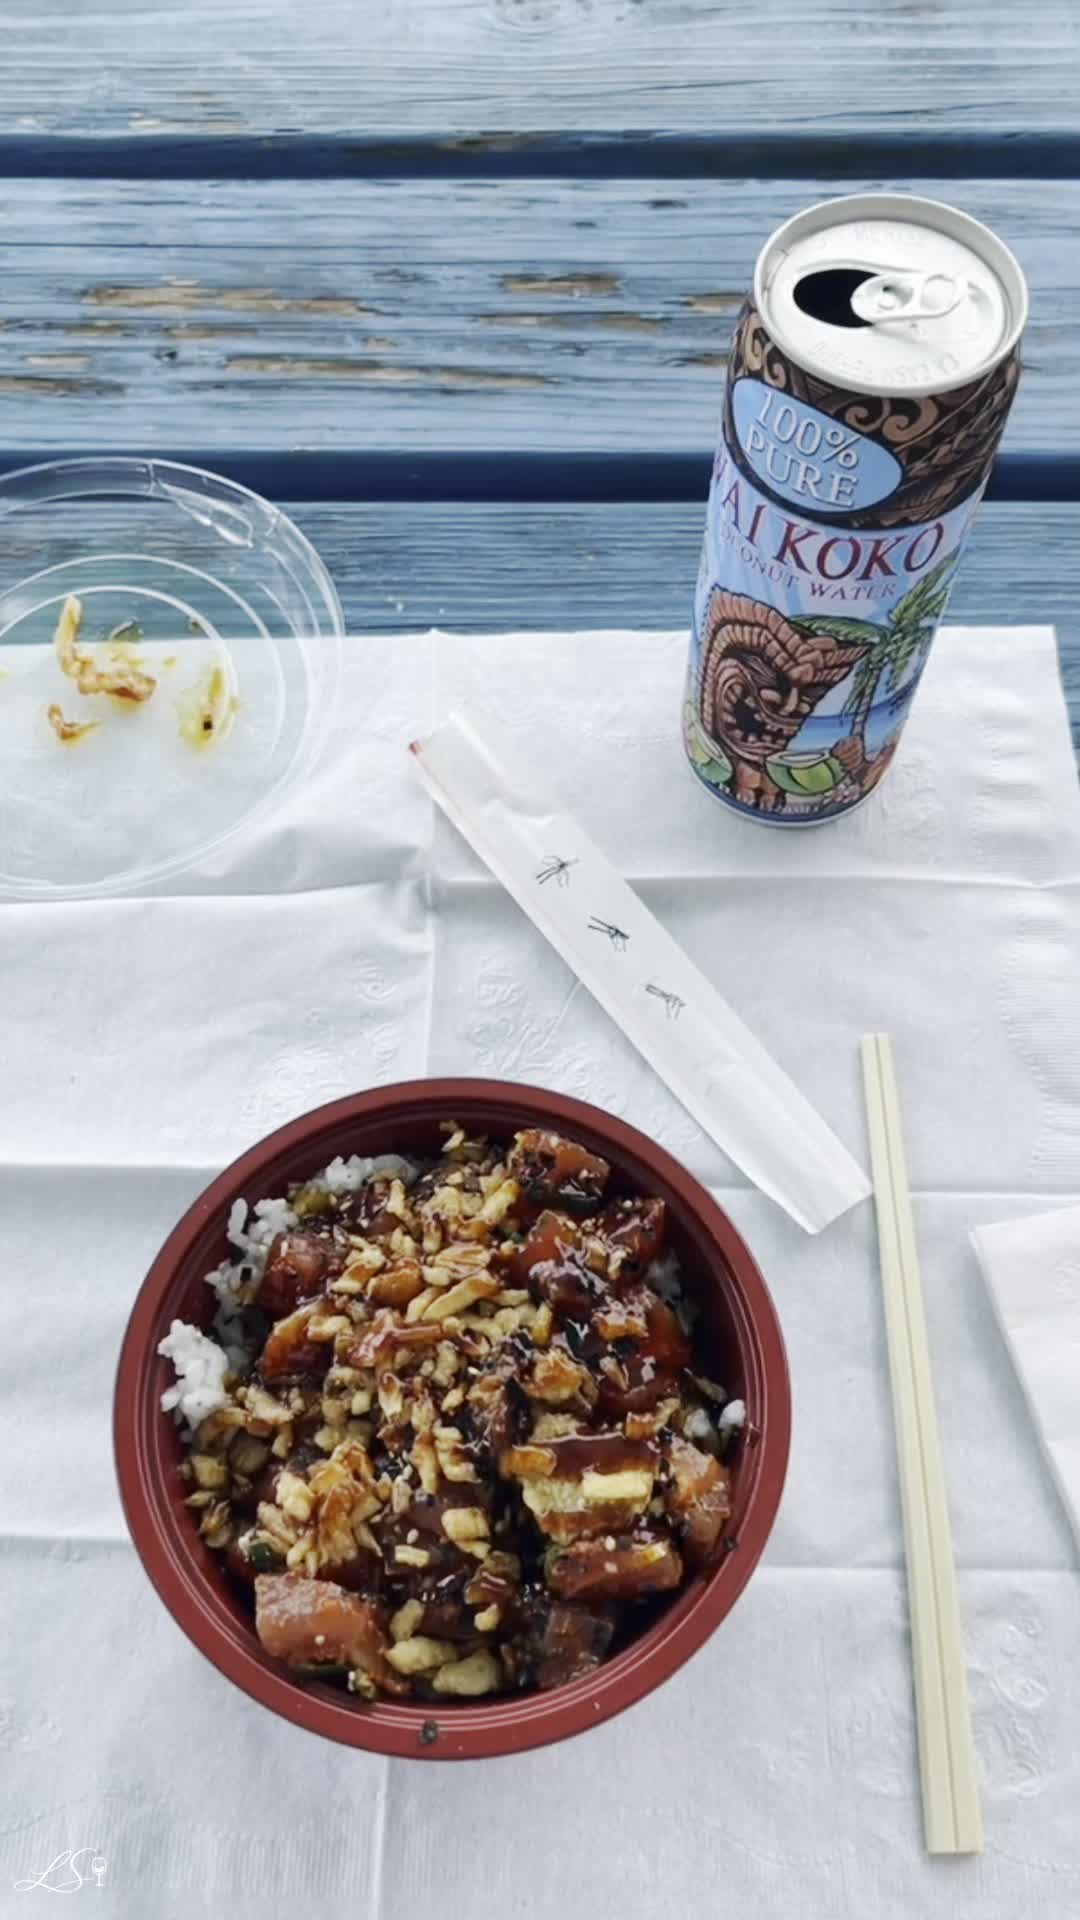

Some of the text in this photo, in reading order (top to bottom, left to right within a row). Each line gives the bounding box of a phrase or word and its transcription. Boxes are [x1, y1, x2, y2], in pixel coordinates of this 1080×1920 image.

[743, 423, 858, 508] PURE
[755, 390, 861, 470] 100%
[773, 514, 944, 582] KOKO
[809, 581, 897, 601] WATER
